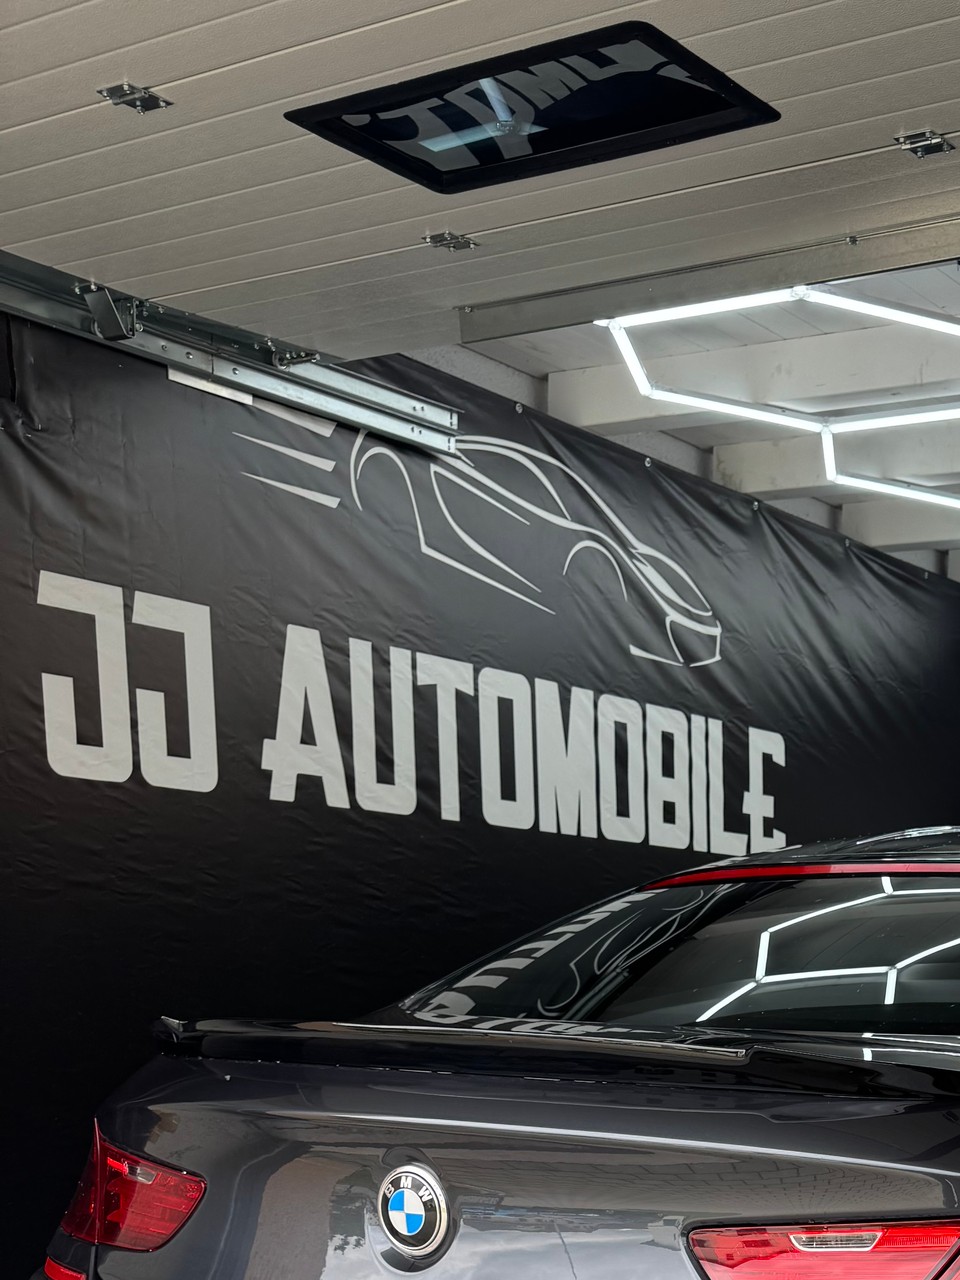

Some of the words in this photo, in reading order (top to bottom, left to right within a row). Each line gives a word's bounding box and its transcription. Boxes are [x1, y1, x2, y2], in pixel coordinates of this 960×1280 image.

[37, 570, 219, 793] JJ
[261, 623, 787, 856] AUTOMOBILE
[384, 1175, 433, 1203] BMW
